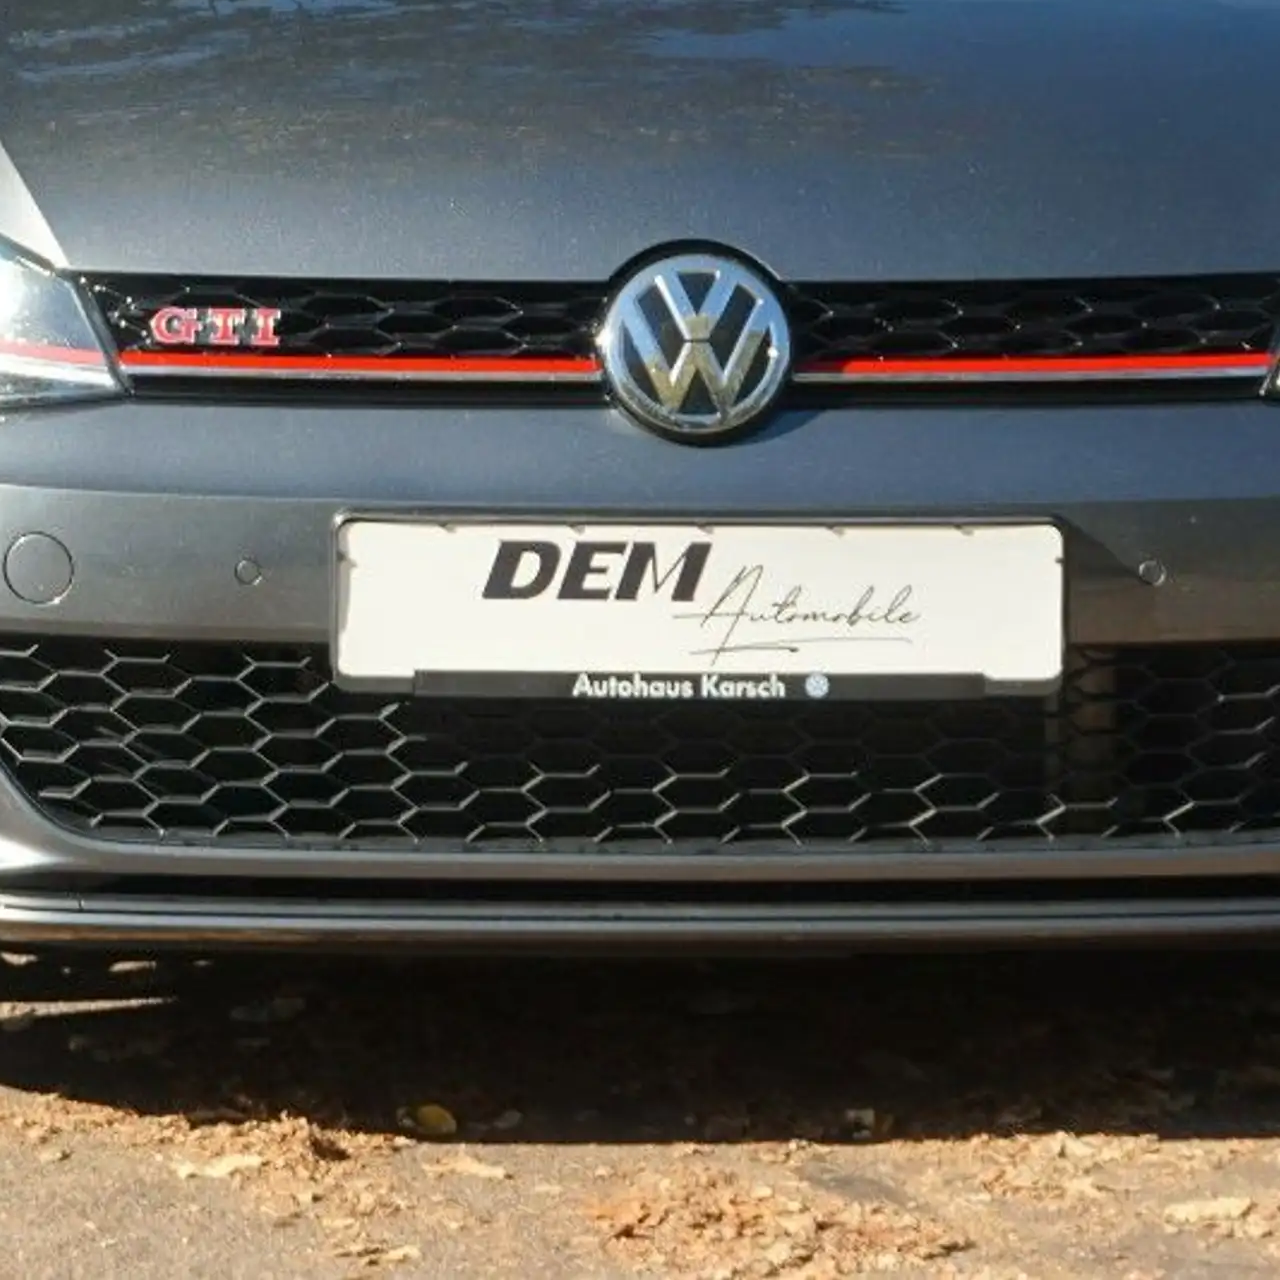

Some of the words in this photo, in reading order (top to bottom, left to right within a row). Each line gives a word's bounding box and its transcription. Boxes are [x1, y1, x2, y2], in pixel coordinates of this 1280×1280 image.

[149, 307, 281, 346] GTI
[481, 539, 712, 602] DEM
[673, 564, 921, 666] Automobile
[572, 672, 694, 699] Autohaus
[700, 672, 787, 699] Karsch
